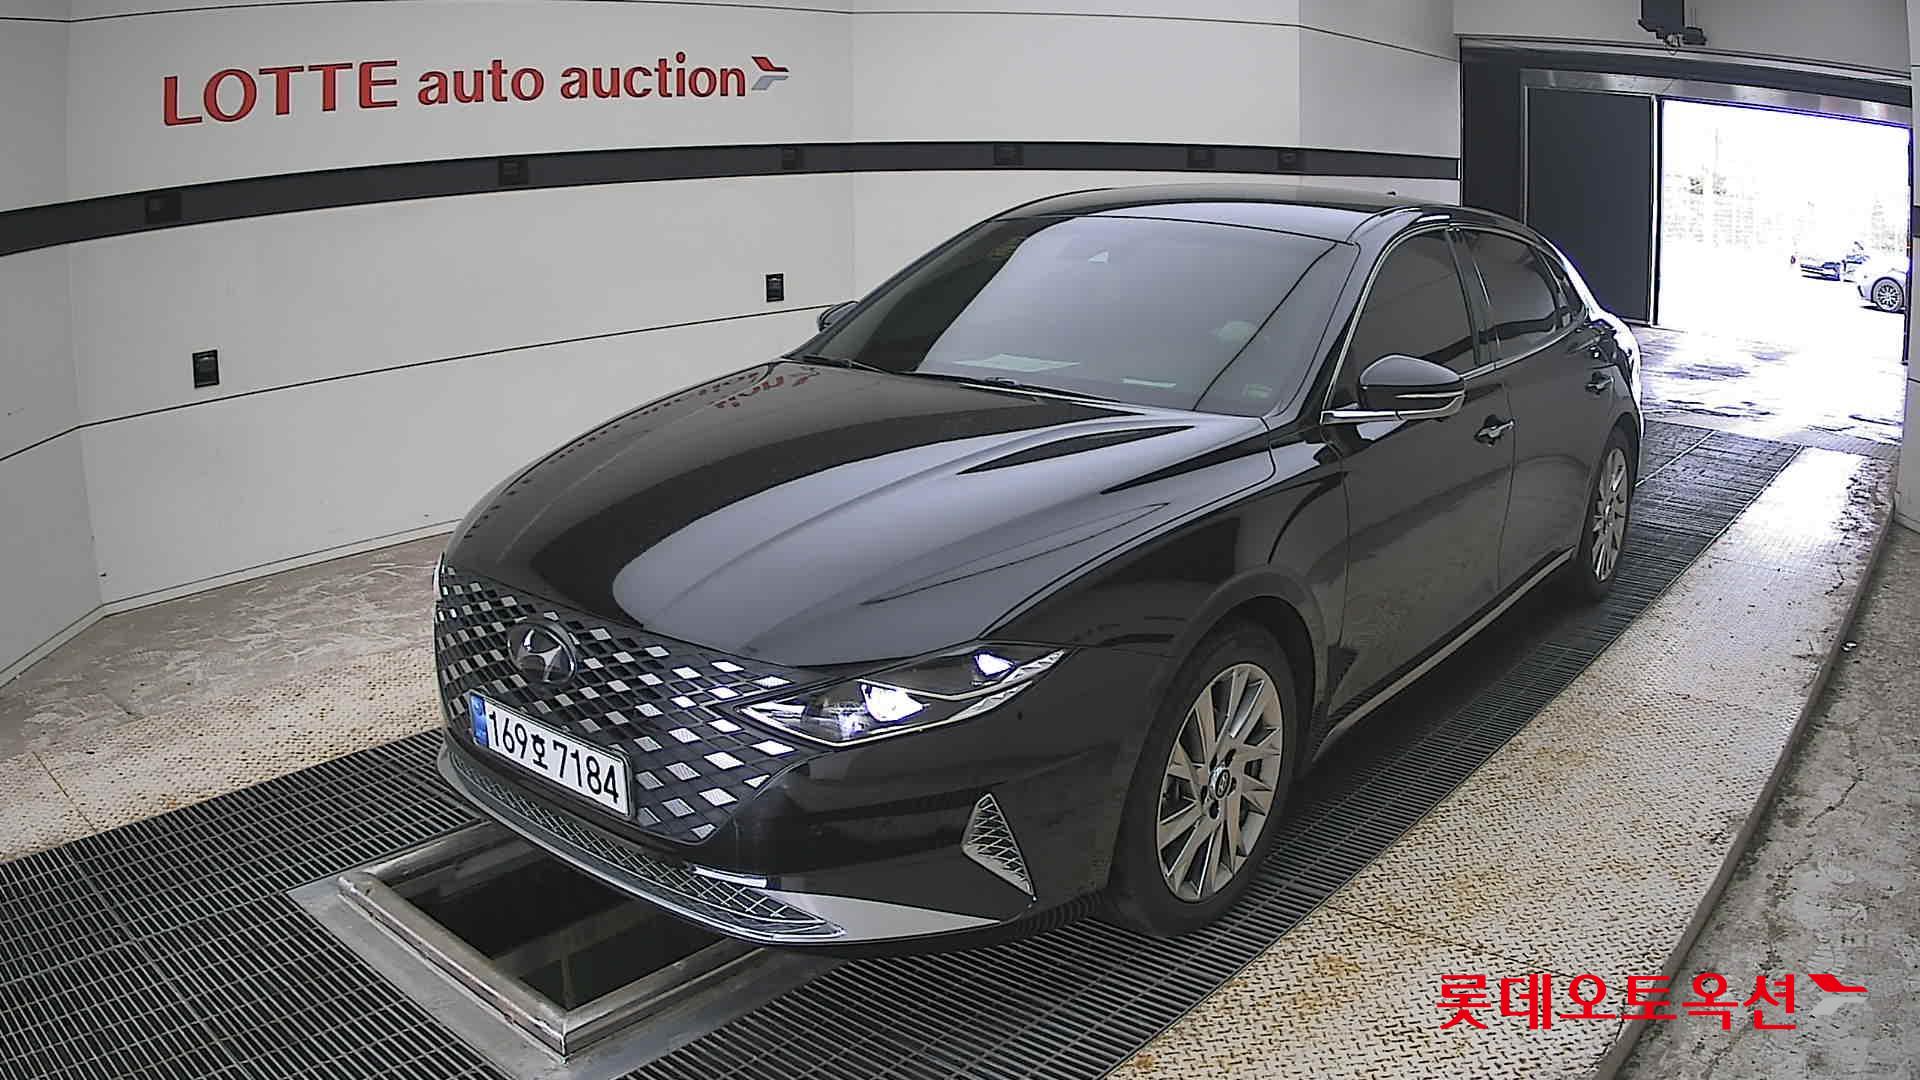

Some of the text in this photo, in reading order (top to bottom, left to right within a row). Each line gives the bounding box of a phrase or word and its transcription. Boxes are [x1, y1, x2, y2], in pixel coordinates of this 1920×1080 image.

[163, 51, 747, 126] LOTTE auto auction
